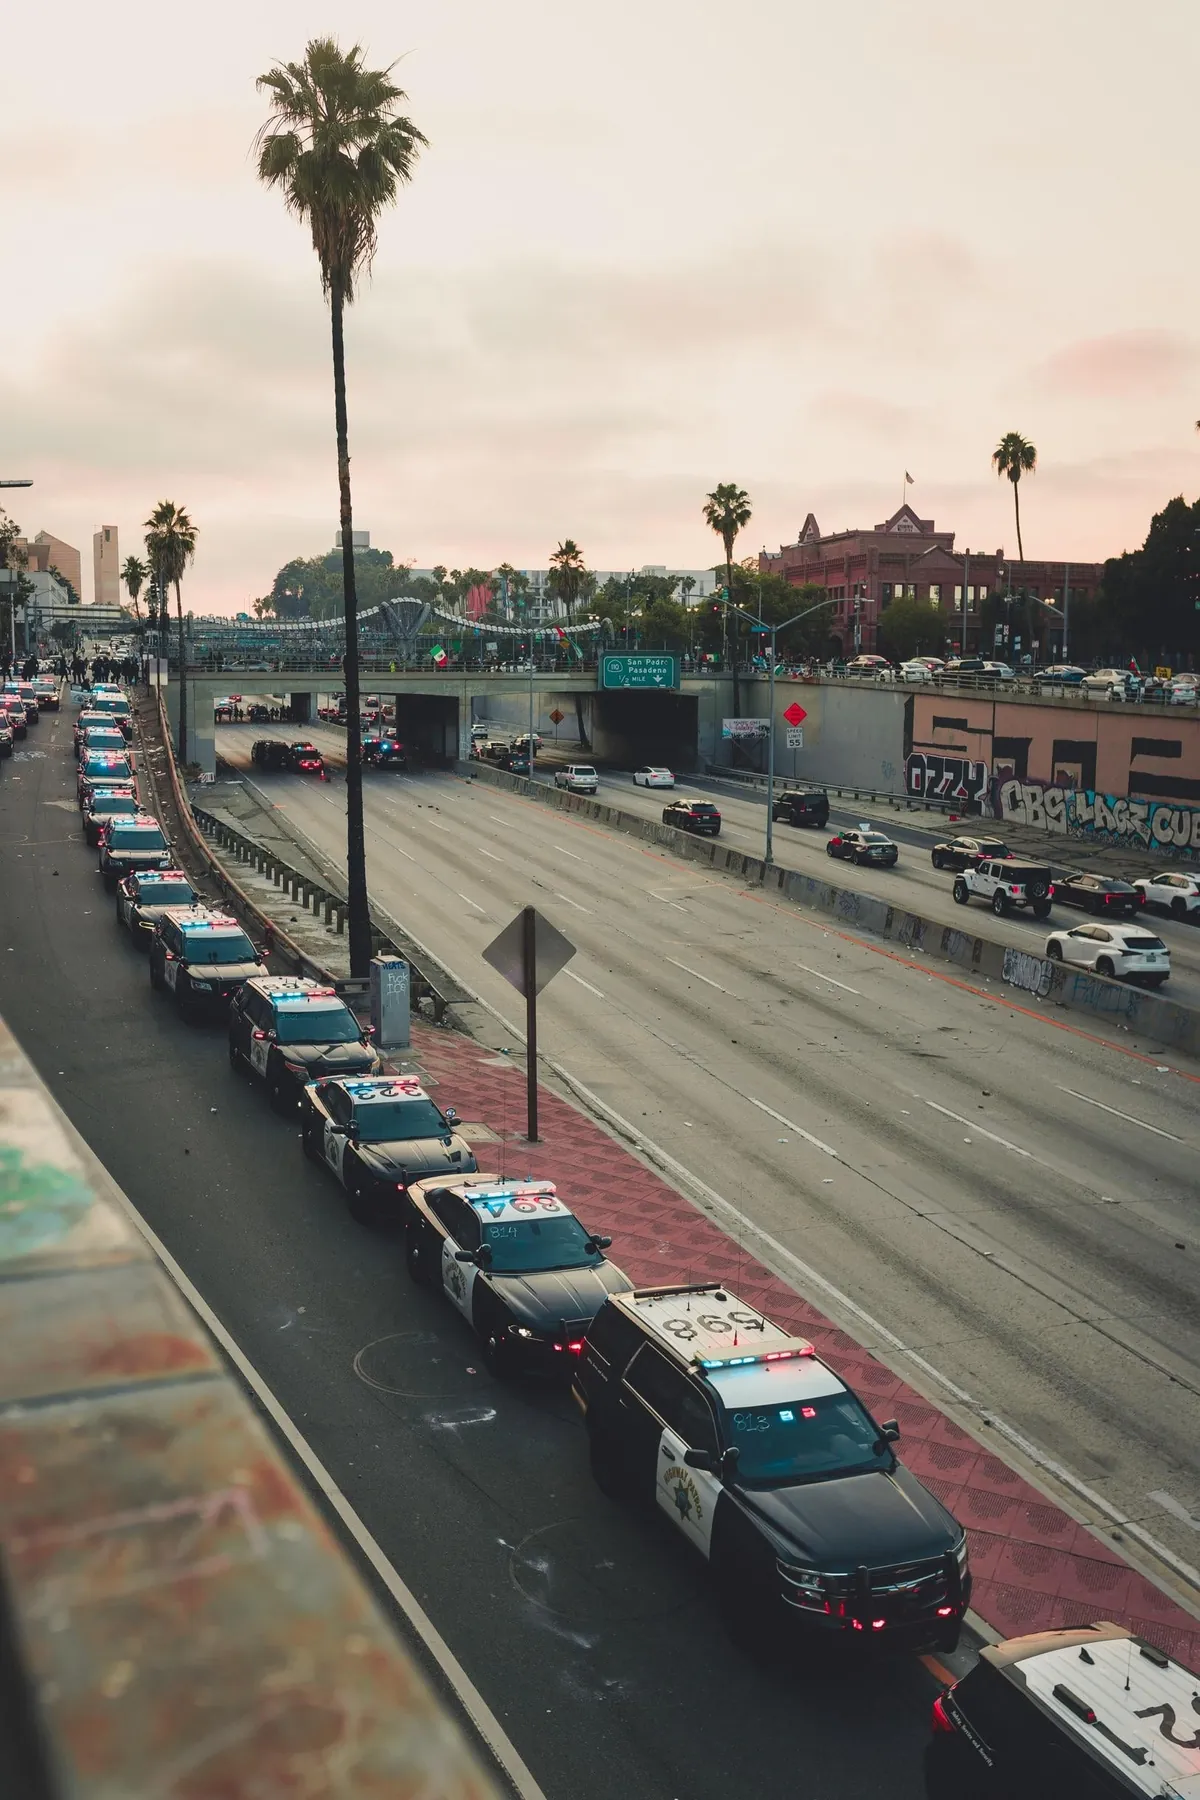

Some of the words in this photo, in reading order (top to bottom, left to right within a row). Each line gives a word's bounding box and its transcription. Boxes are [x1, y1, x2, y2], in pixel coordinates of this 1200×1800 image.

[627, 658, 642, 666] San
[789, 739, 801, 747] 55
[904, 751, 990, 816] OZZY
[354, 1086, 422, 1100] 323
[490, 1226, 518, 1239] 814
[733, 1412, 770, 1432] 813
